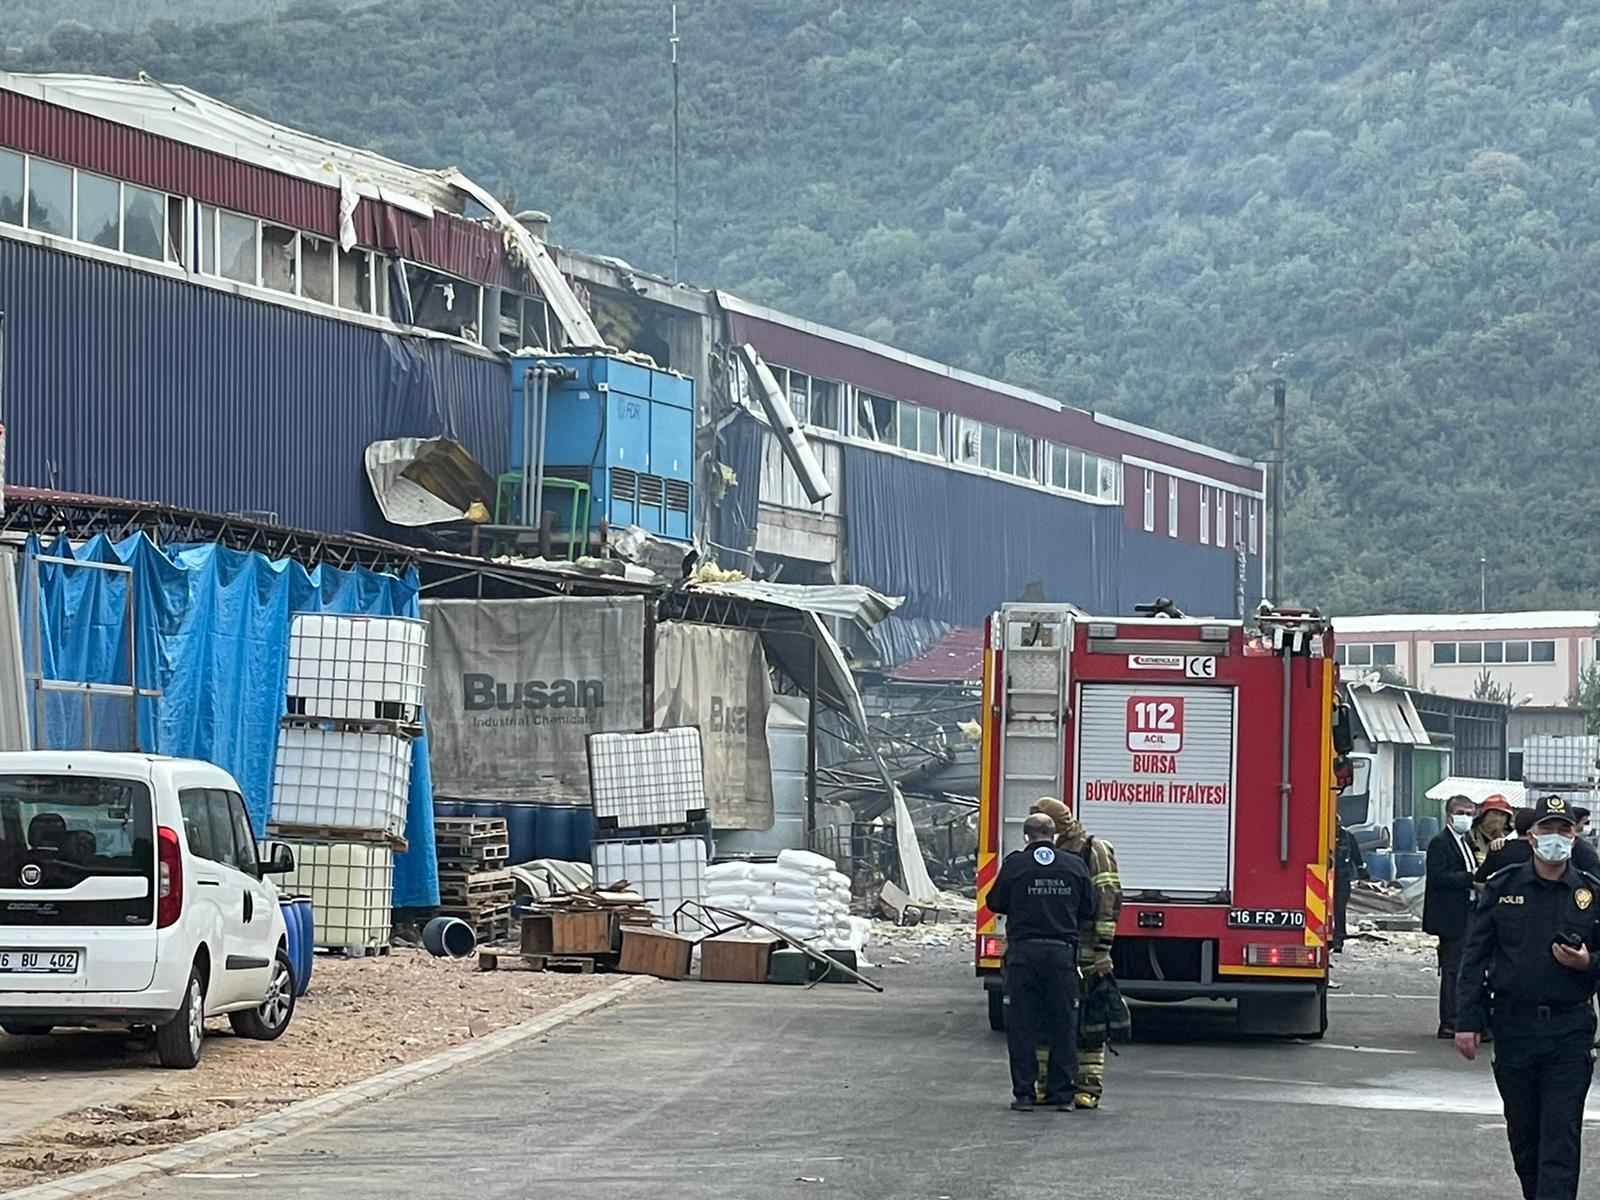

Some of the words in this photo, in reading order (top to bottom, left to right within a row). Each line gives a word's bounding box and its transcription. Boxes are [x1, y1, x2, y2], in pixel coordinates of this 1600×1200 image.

[463, 673, 604, 711] Busan
[473, 715, 529, 727] Industrial
[533, 713, 596, 726] Chemicals
[1135, 702, 1175, 729] 112
[1133, 754, 1176, 774] BURSA
[1085, 780, 1164, 805] BÜYÜKŞEHİR
[1168, 781, 1227, 804] İTFAİYESİ
[1035, 879, 1065, 887] BURSA
[1236, 911, 1250, 923] 16
[1256, 912, 1275, 924] FR
[1281, 912, 1303, 925] 710
[21, 953, 38, 966] BU
[49, 954, 75, 967] 402
